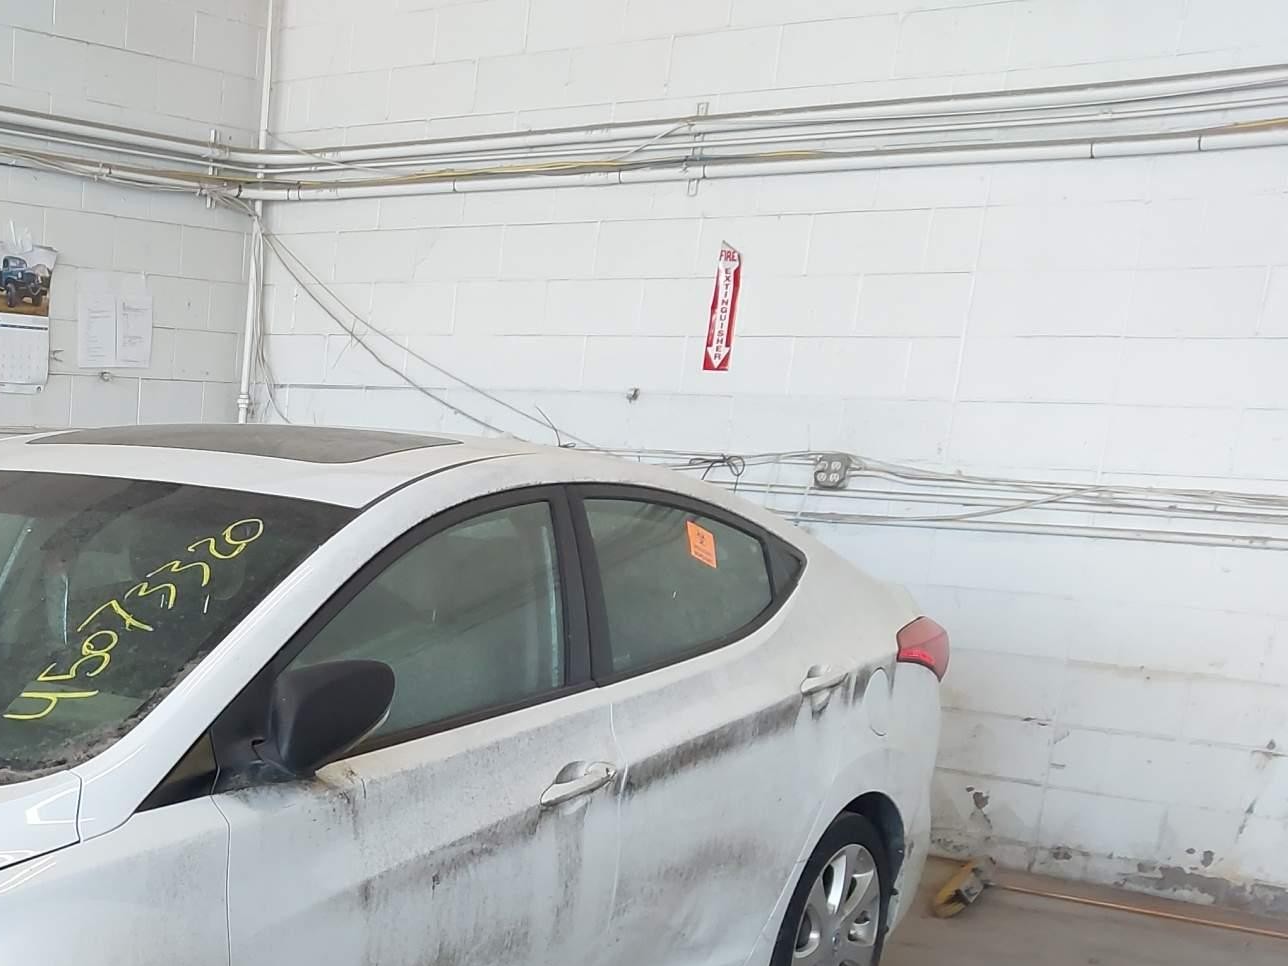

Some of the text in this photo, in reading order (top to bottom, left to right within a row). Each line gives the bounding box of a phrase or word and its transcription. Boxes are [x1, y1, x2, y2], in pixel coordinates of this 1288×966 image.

[720, 250, 737, 262] FIRE
[714, 268, 731, 360] EXTINGUISHER
[2, 518, 264, 719] 45073320
